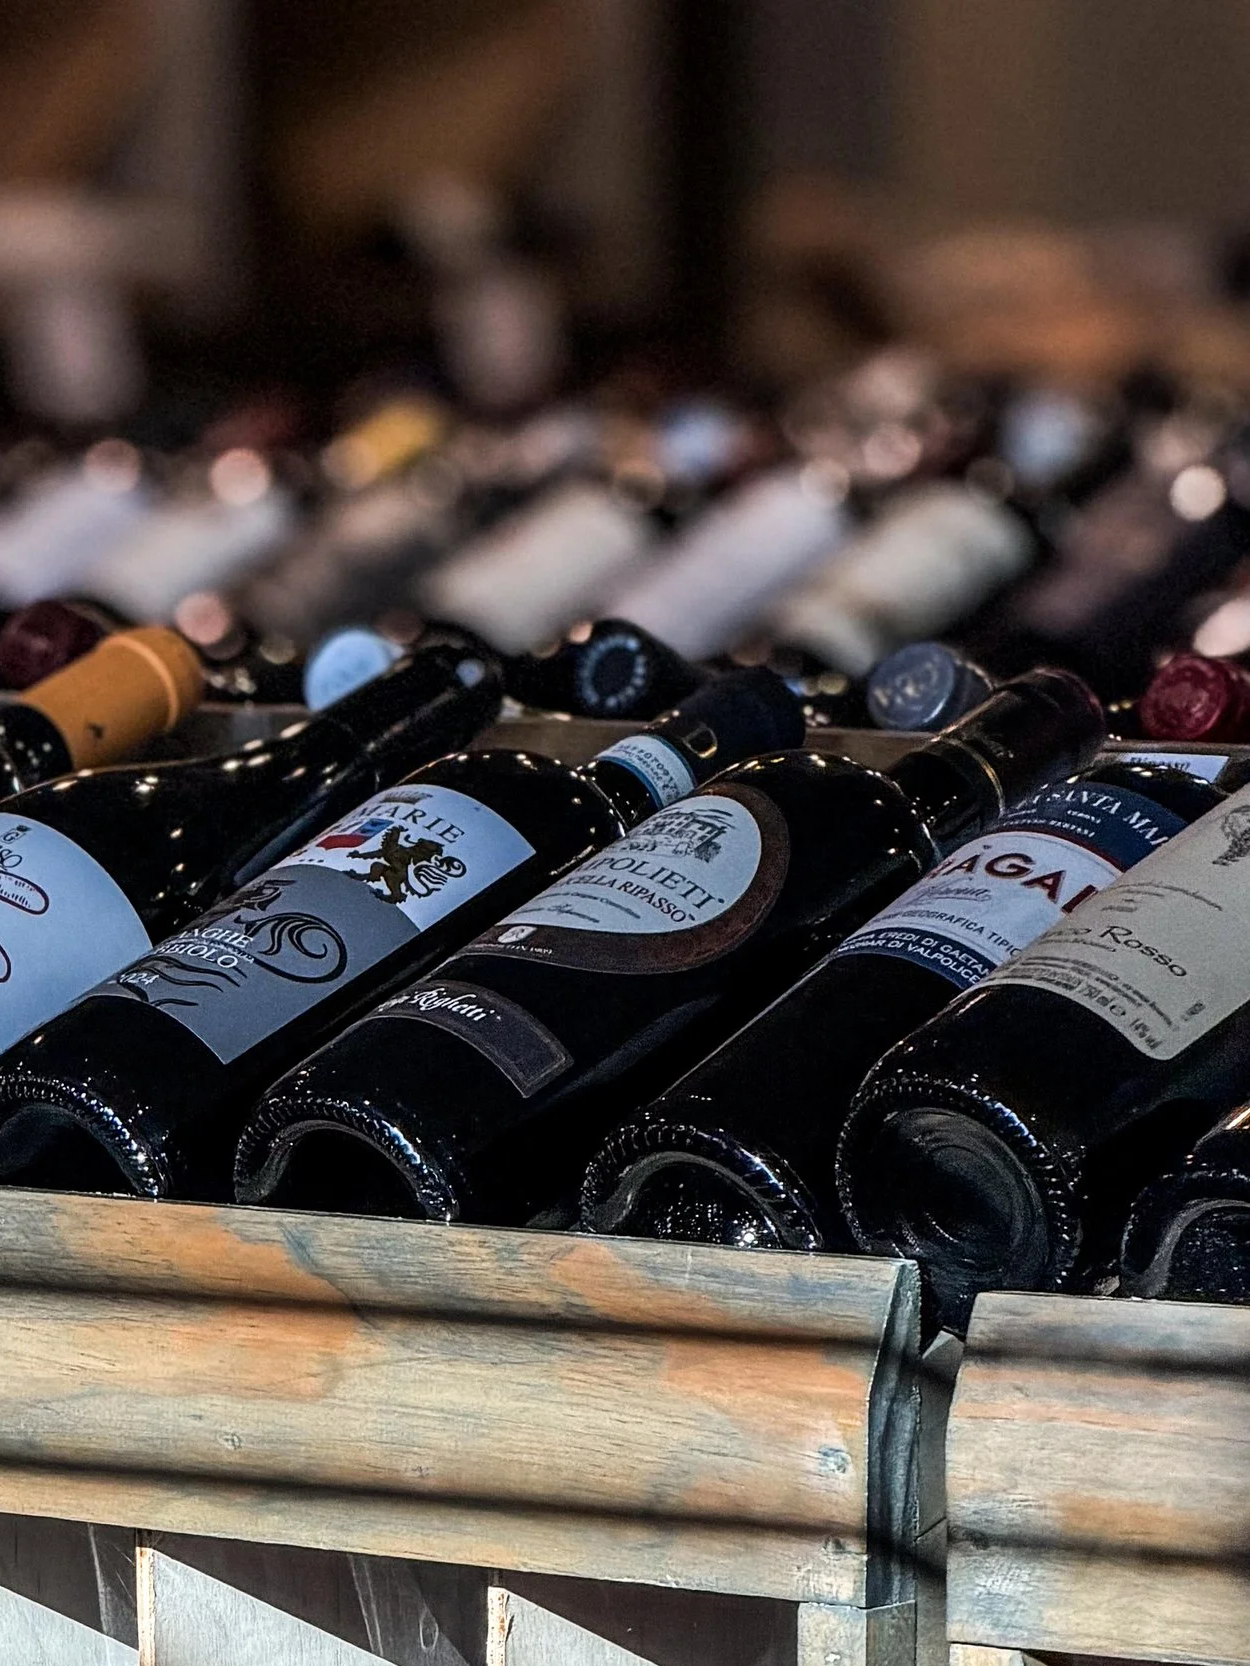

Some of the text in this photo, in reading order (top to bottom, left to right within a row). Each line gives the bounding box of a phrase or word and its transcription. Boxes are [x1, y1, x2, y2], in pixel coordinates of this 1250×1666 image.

[616, 881, 686, 923] RIPASSO
[907, 943, 981, 984] VALPOLICE
[987, 931, 1023, 957] TIPIC
[1100, 925, 1187, 978] Rosso
[409, 987, 495, 1021] Righetti
